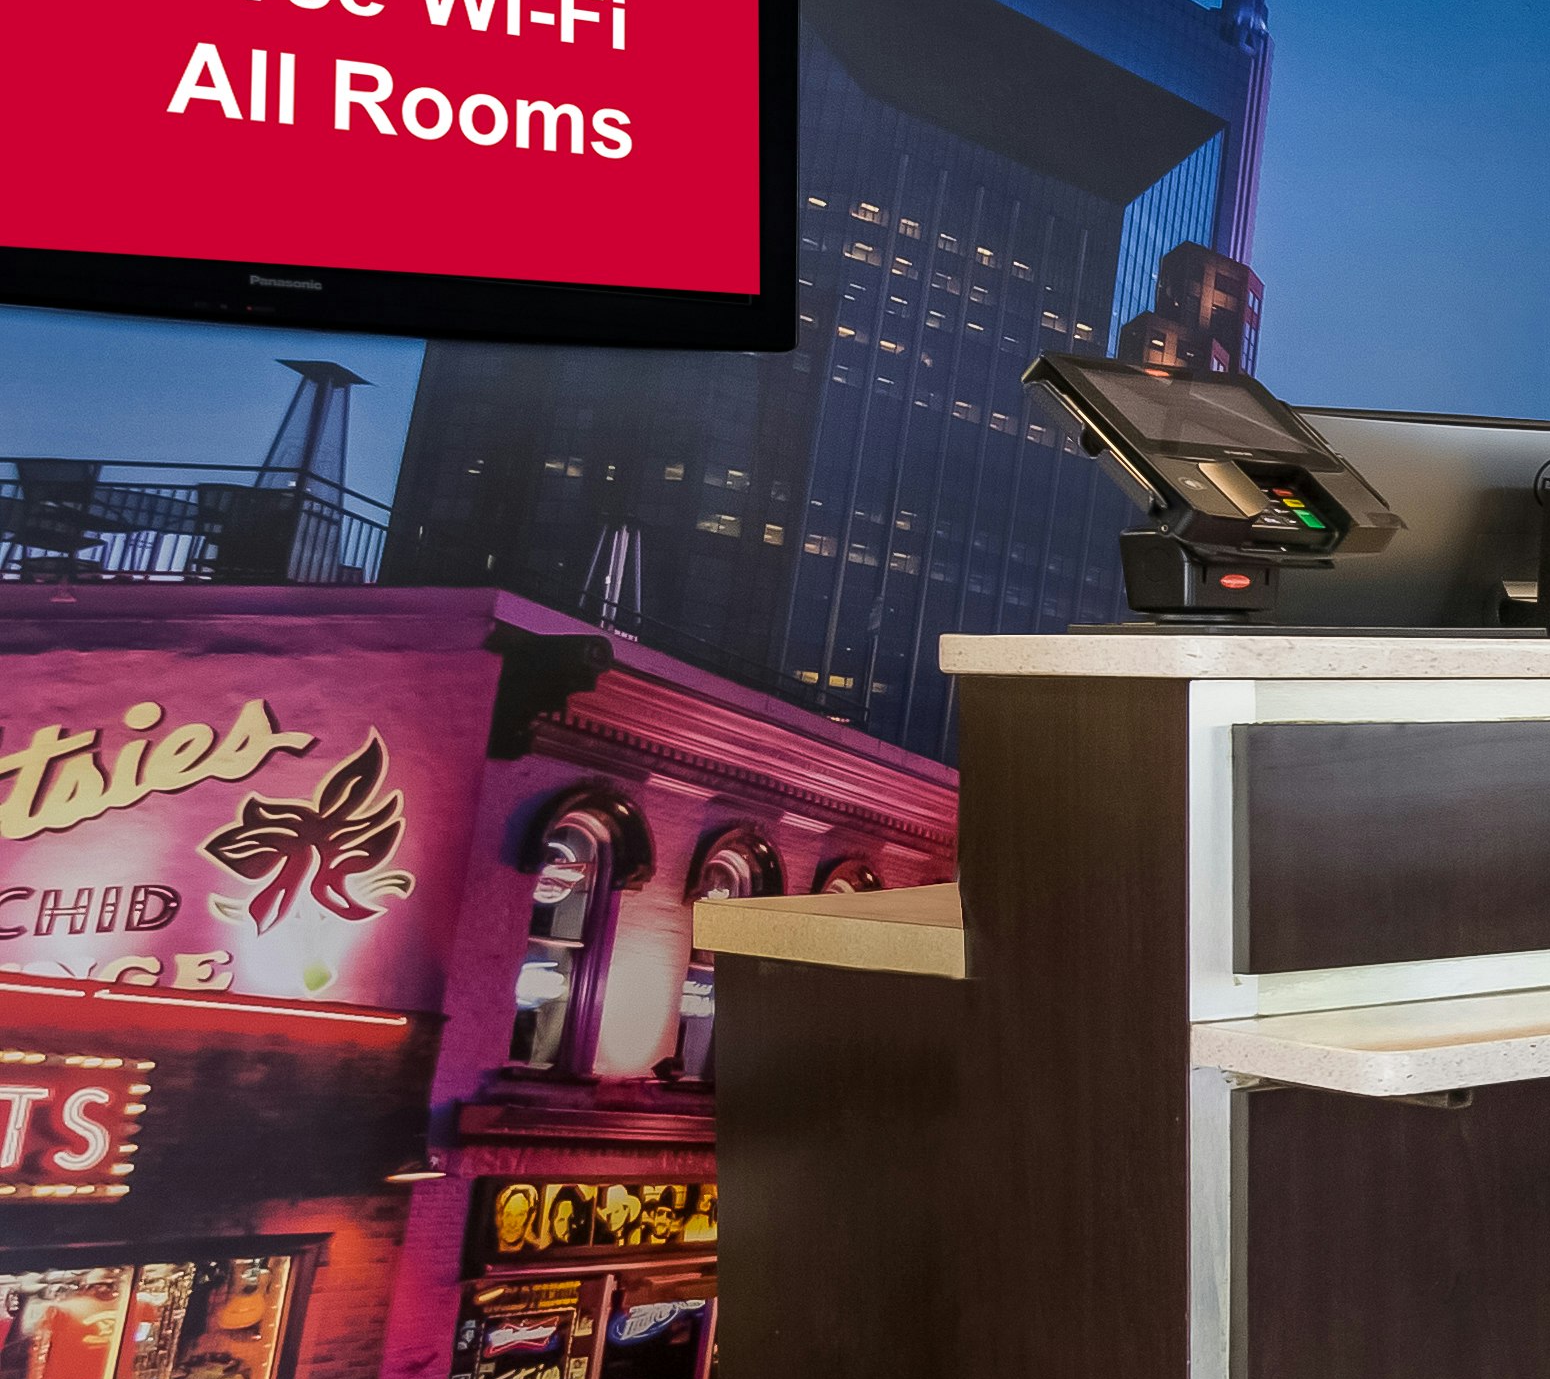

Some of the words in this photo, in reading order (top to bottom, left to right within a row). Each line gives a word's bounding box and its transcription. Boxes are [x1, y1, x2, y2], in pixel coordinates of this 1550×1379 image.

[166, 42, 296, 125] All
[334, 58, 634, 159] Rooms
[249, 274, 323, 291] Panasonic
[0, 1085, 111, 1171] TS
